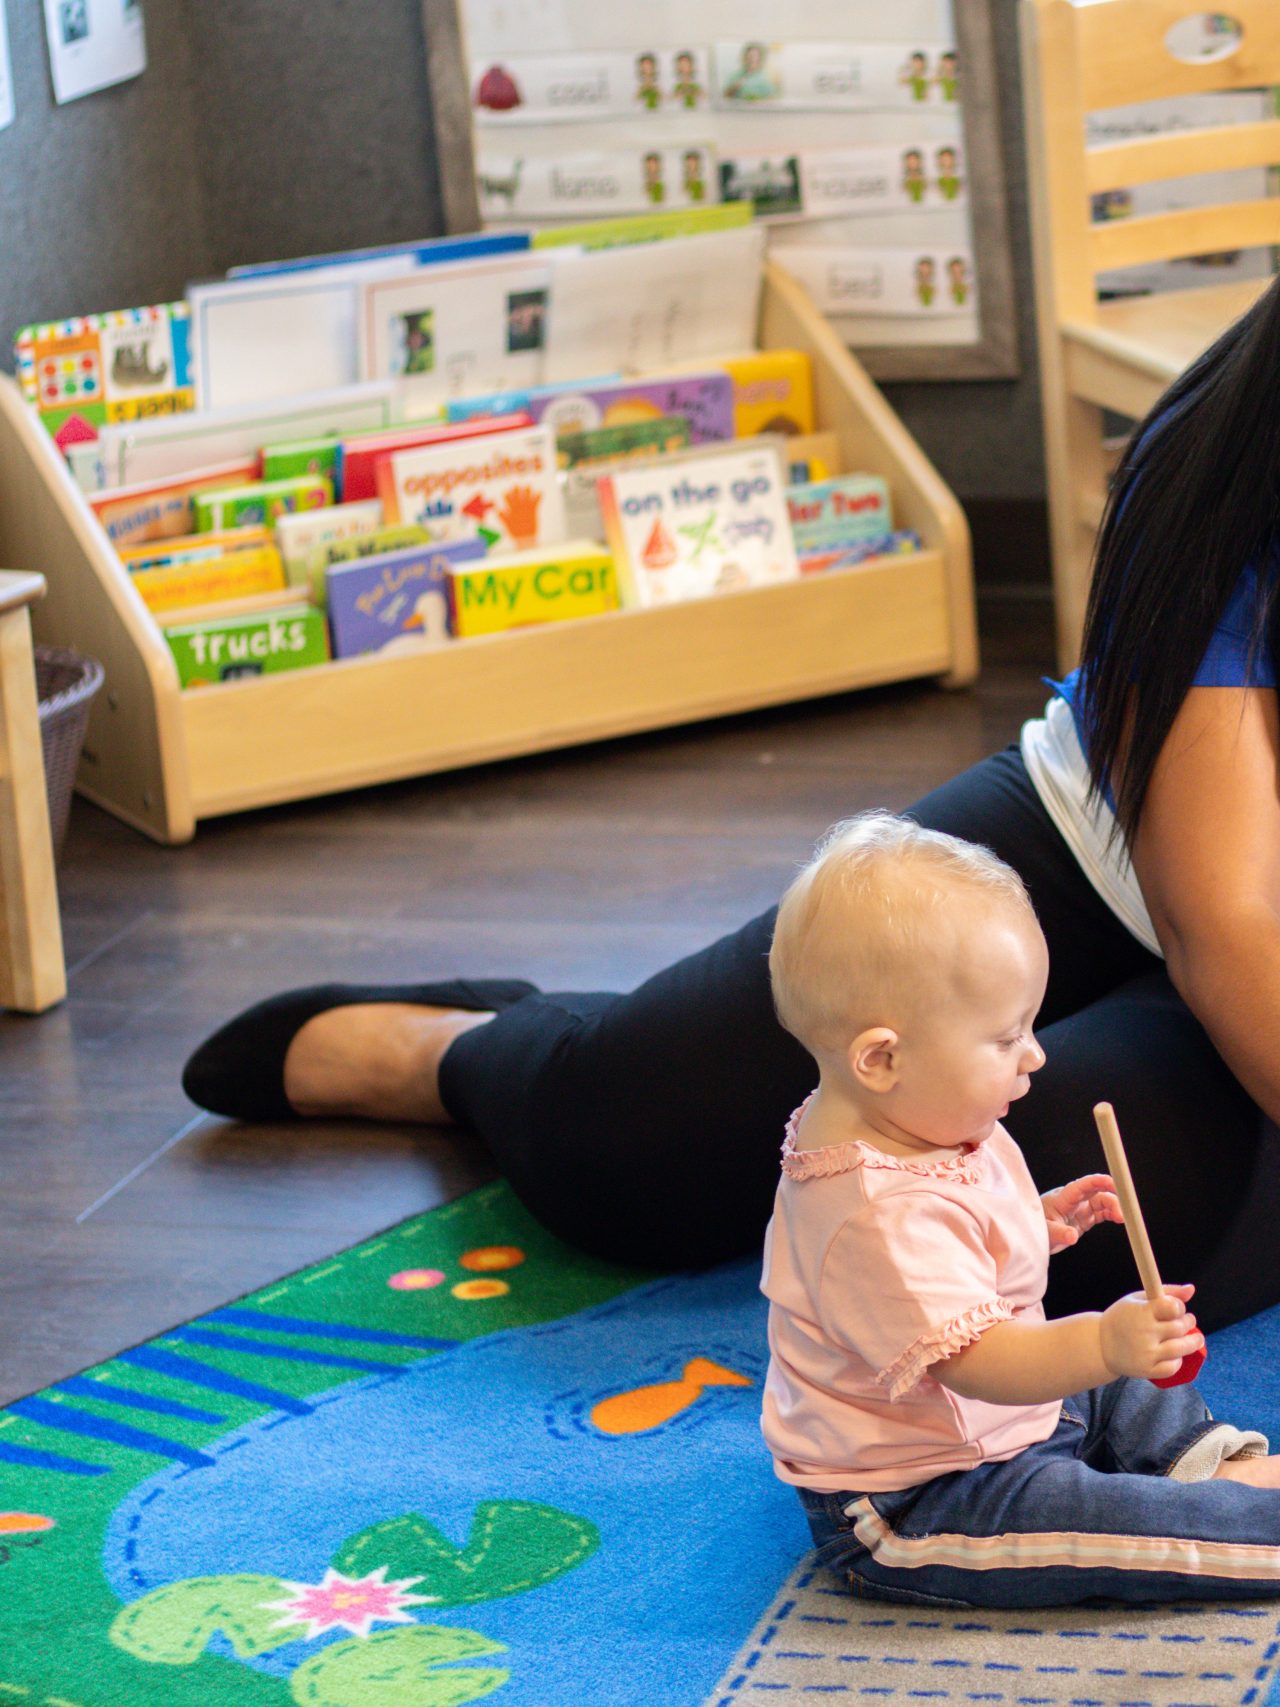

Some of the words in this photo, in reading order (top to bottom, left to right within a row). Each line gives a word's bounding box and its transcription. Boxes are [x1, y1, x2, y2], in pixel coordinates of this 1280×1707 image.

[404, 453, 543, 498] opposites
[623, 494, 663, 515] on
[671, 478, 720, 504] the
[730, 475, 770, 505] go
[462, 574, 522, 613] My
[533, 563, 609, 600] Car
[189, 617, 306, 665] trucks
